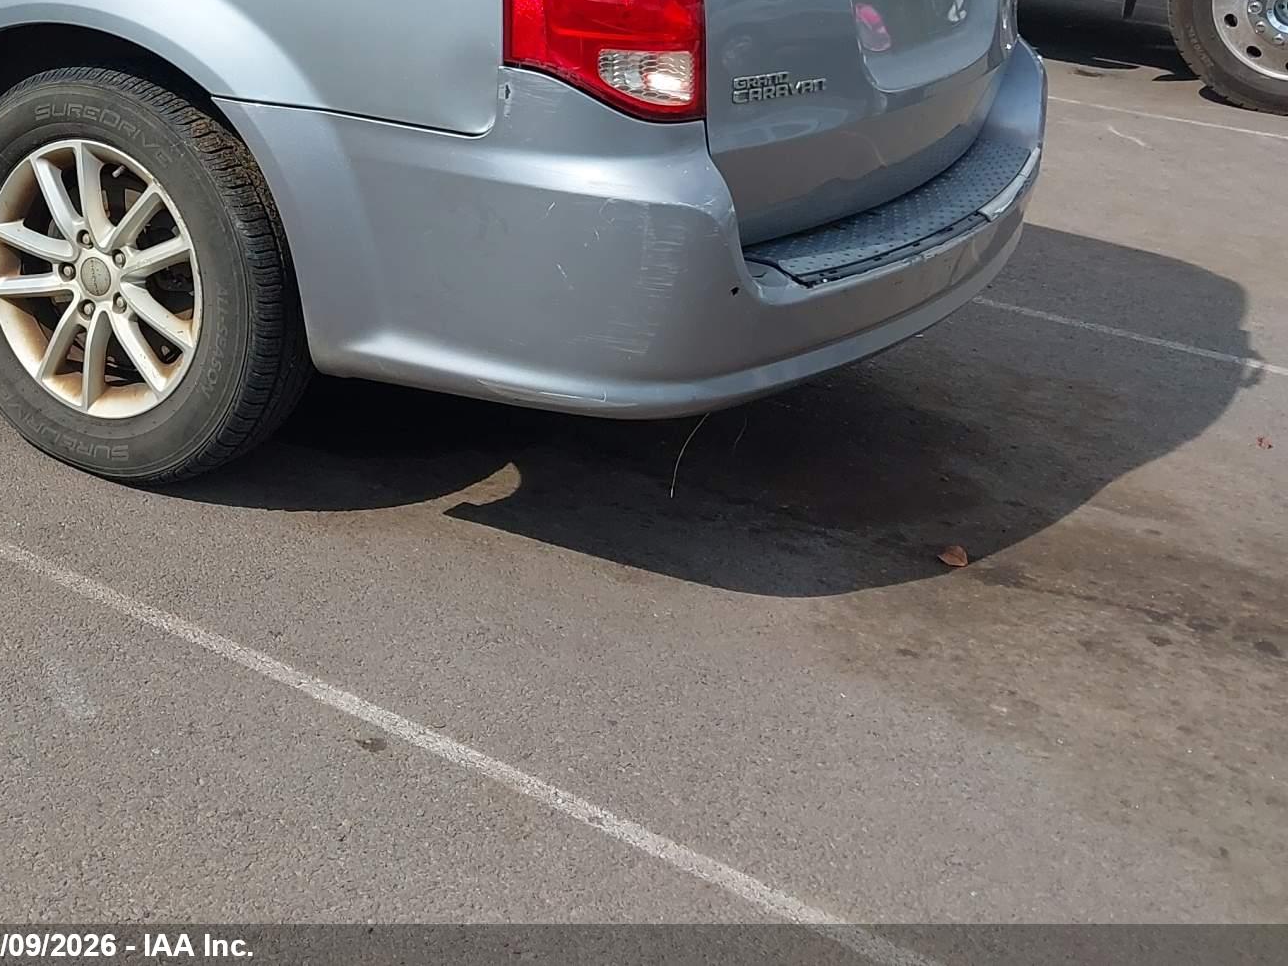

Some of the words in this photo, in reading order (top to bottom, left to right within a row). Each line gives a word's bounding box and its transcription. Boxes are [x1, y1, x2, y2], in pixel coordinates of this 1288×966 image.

[732, 77, 827, 104] CARAVAN
[733, 71, 790, 90] GRAND
[34, 103, 173, 167] SUREDRIVE
